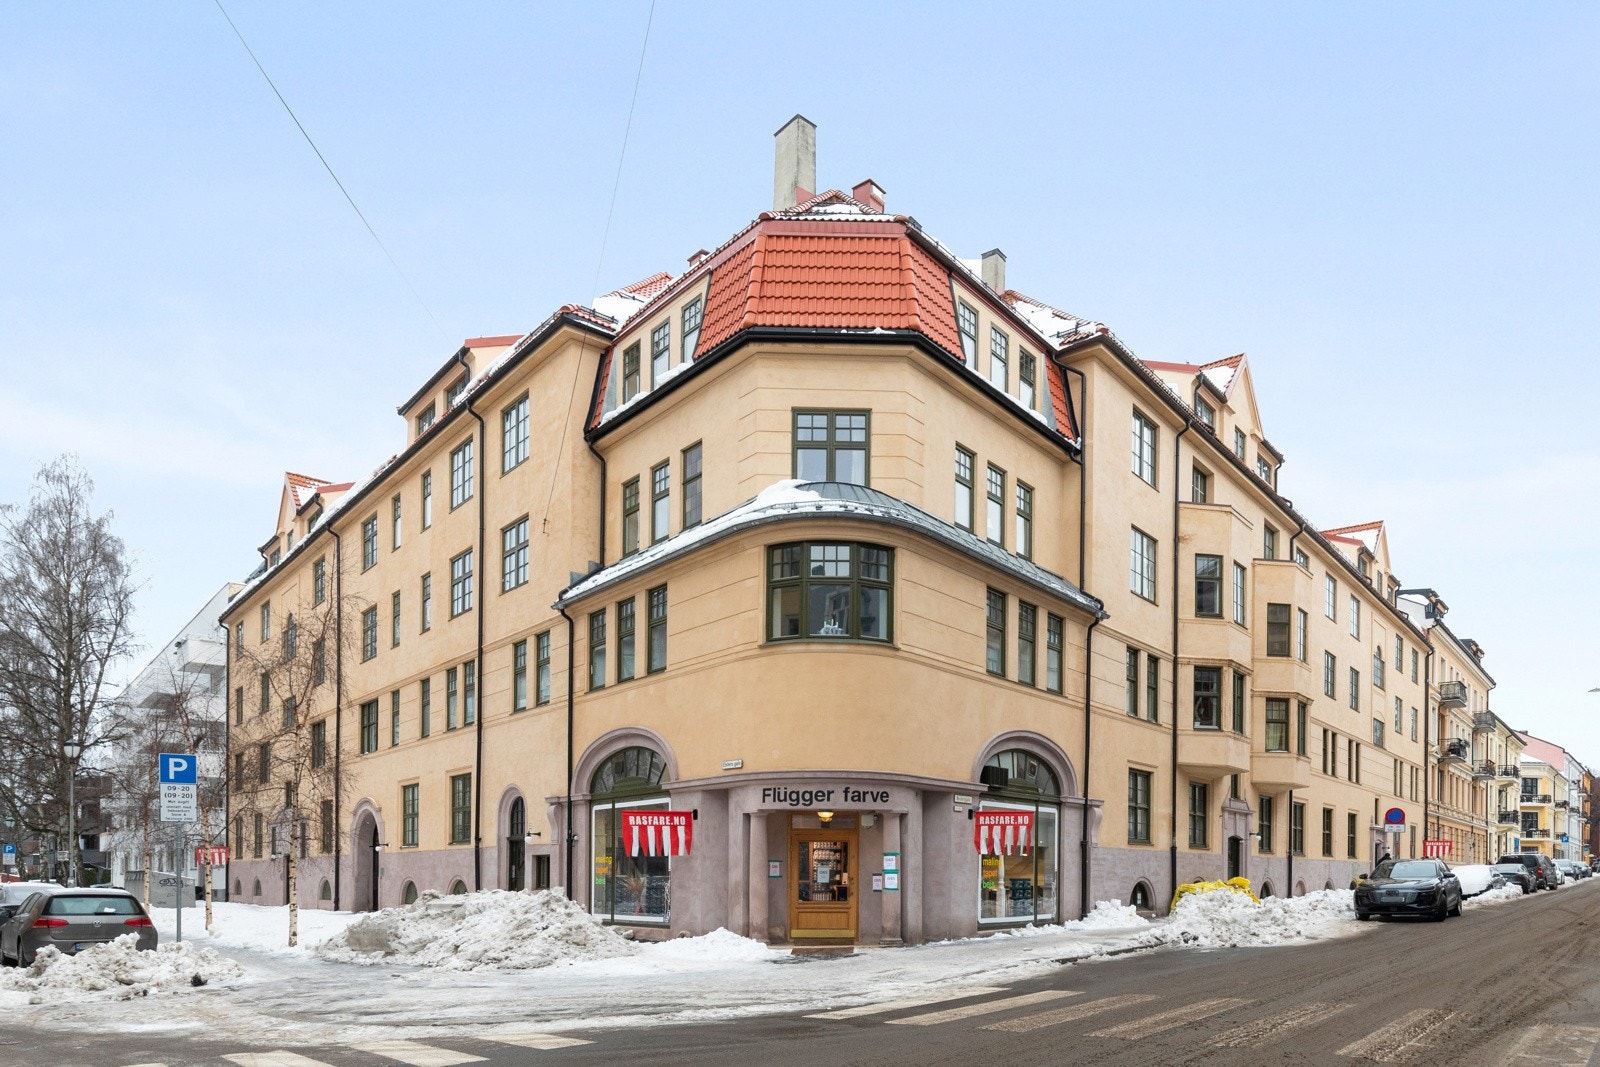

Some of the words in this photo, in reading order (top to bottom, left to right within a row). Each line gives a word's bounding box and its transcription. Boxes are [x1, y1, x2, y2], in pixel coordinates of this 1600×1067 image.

[168, 757, 188, 780] P
[762, 787, 834, 806] Flügger
[843, 786, 890, 803] farve
[628, 815, 686, 825] RASFARE.NO
[979, 815, 1029, 825] RASFARE.NO
[5, 845, 13, 853] P
